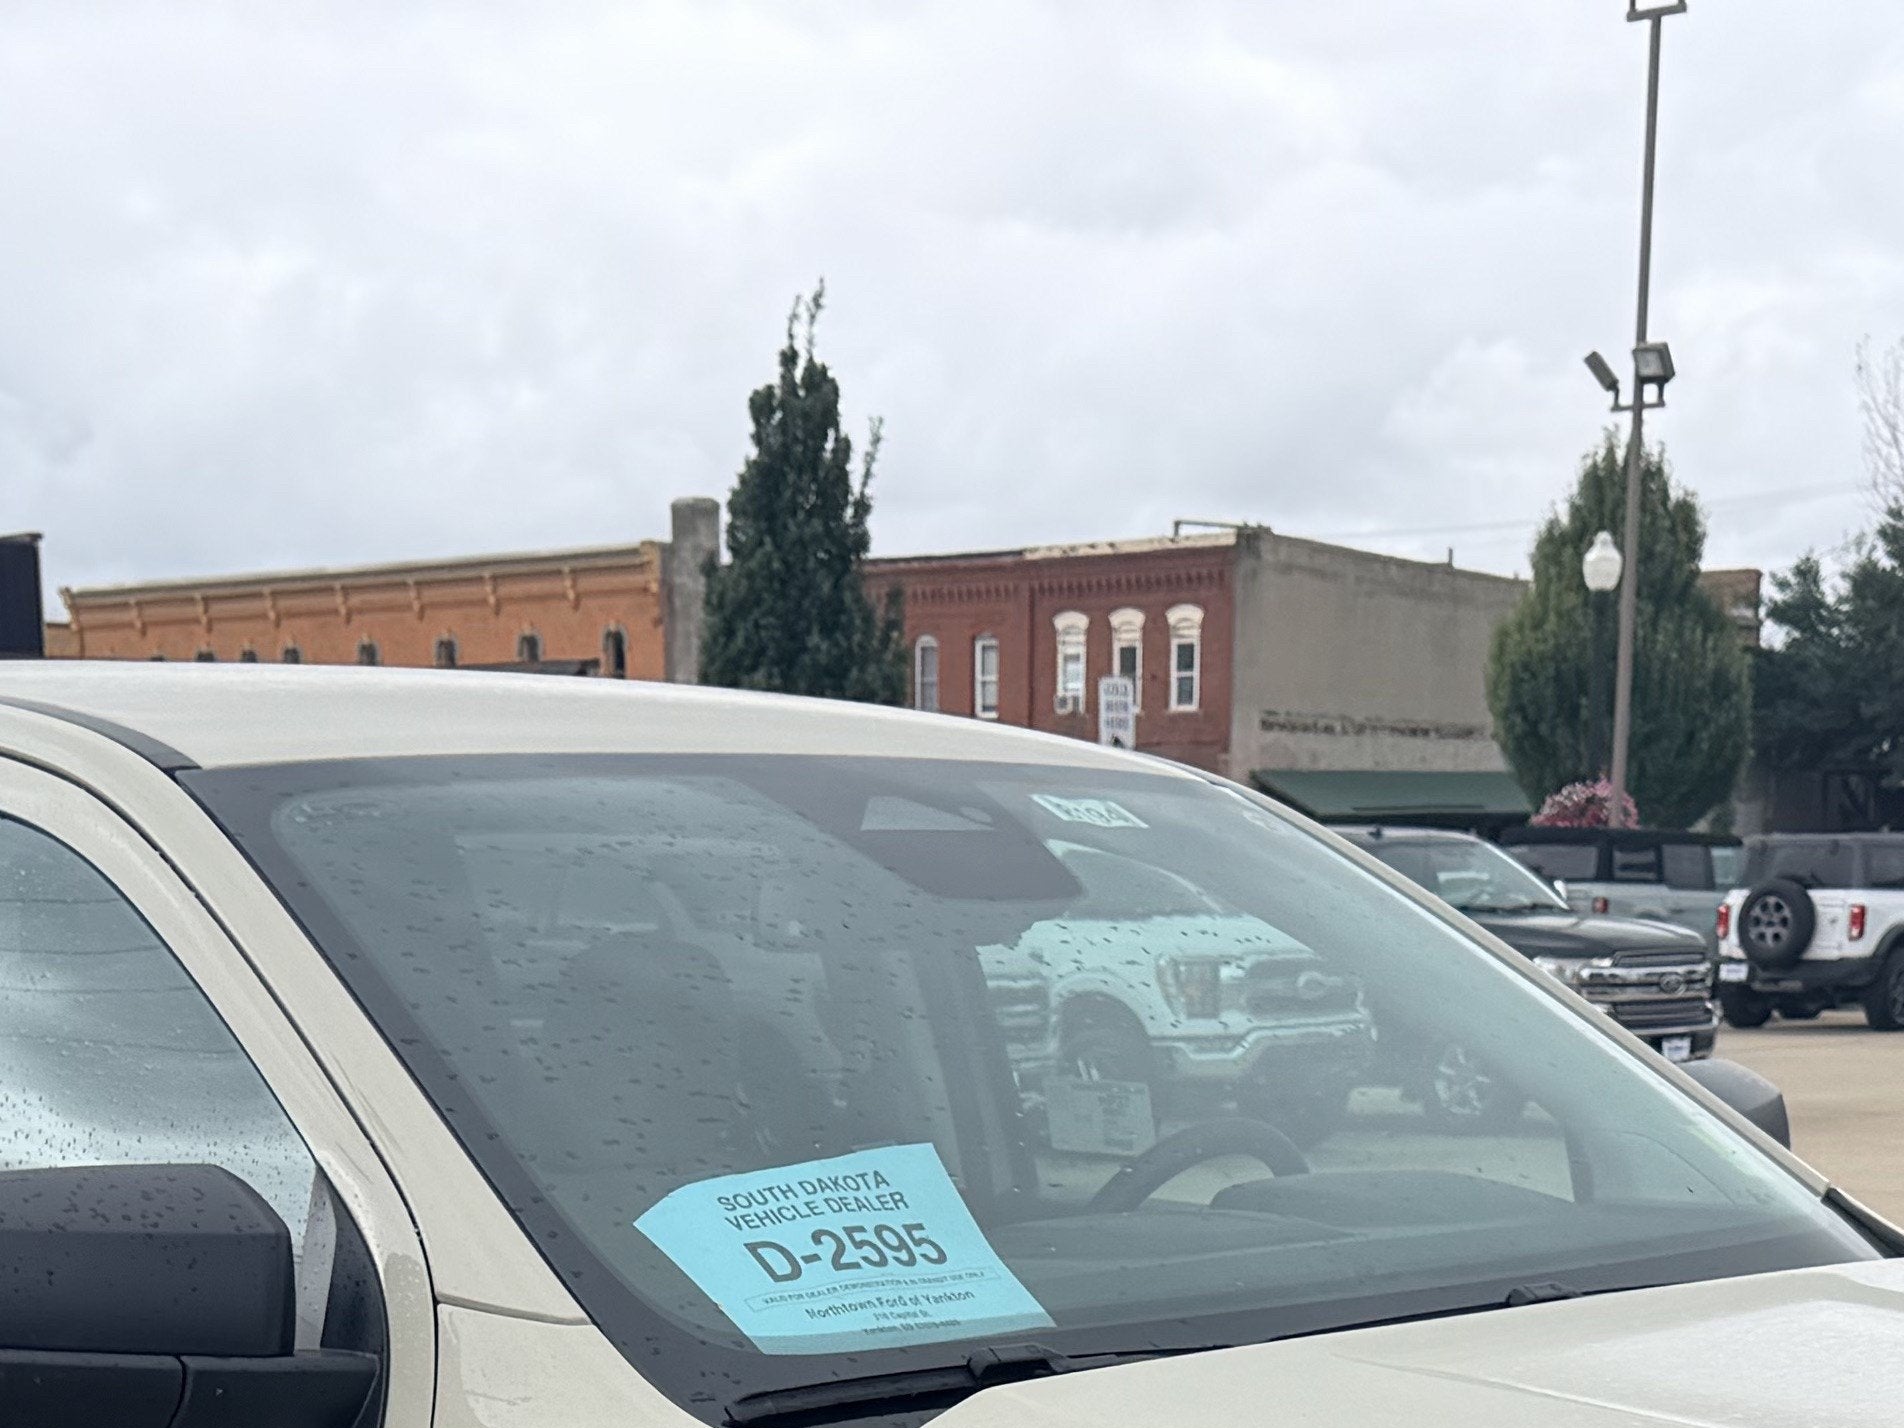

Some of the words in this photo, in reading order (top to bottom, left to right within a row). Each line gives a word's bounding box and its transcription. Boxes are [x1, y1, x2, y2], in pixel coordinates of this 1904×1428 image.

[717, 1183, 799, 1212] SOUTH
[797, 1169, 890, 1197] DAKOTA
[724, 1200, 826, 1232] VEHICLE
[820, 1191, 910, 1214] DEALER
[743, 1222, 948, 1283] D-2595
[805, 1299, 877, 1319] Northtown
[876, 1295, 908, 1308] Ford
[921, 1291, 976, 1305] Yankton
